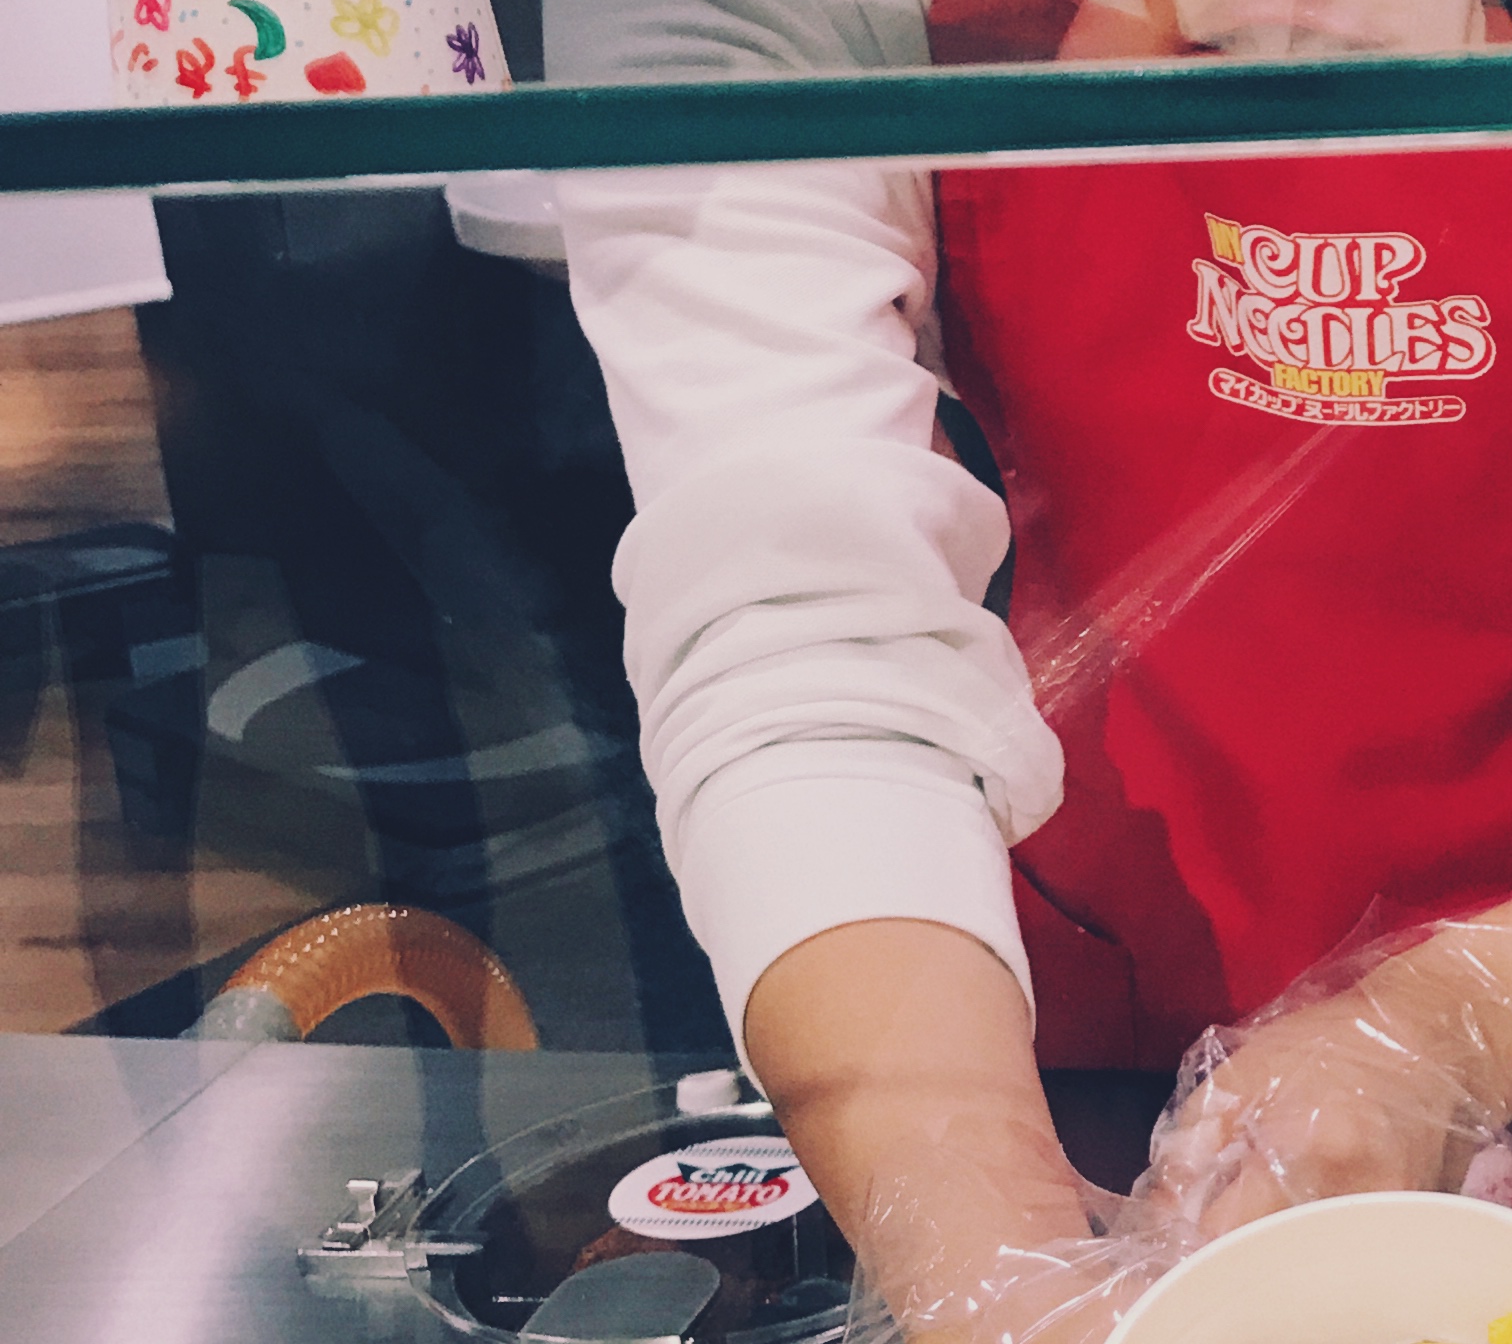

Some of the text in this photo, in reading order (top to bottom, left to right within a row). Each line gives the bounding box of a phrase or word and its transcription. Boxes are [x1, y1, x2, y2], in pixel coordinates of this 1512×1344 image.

[1243, 227, 1420, 304] CUP
[1196, 262, 1490, 372] NOODLES
[1274, 363, 1384, 397] FACTORY
[655, 1182, 782, 1205] TOMATO
